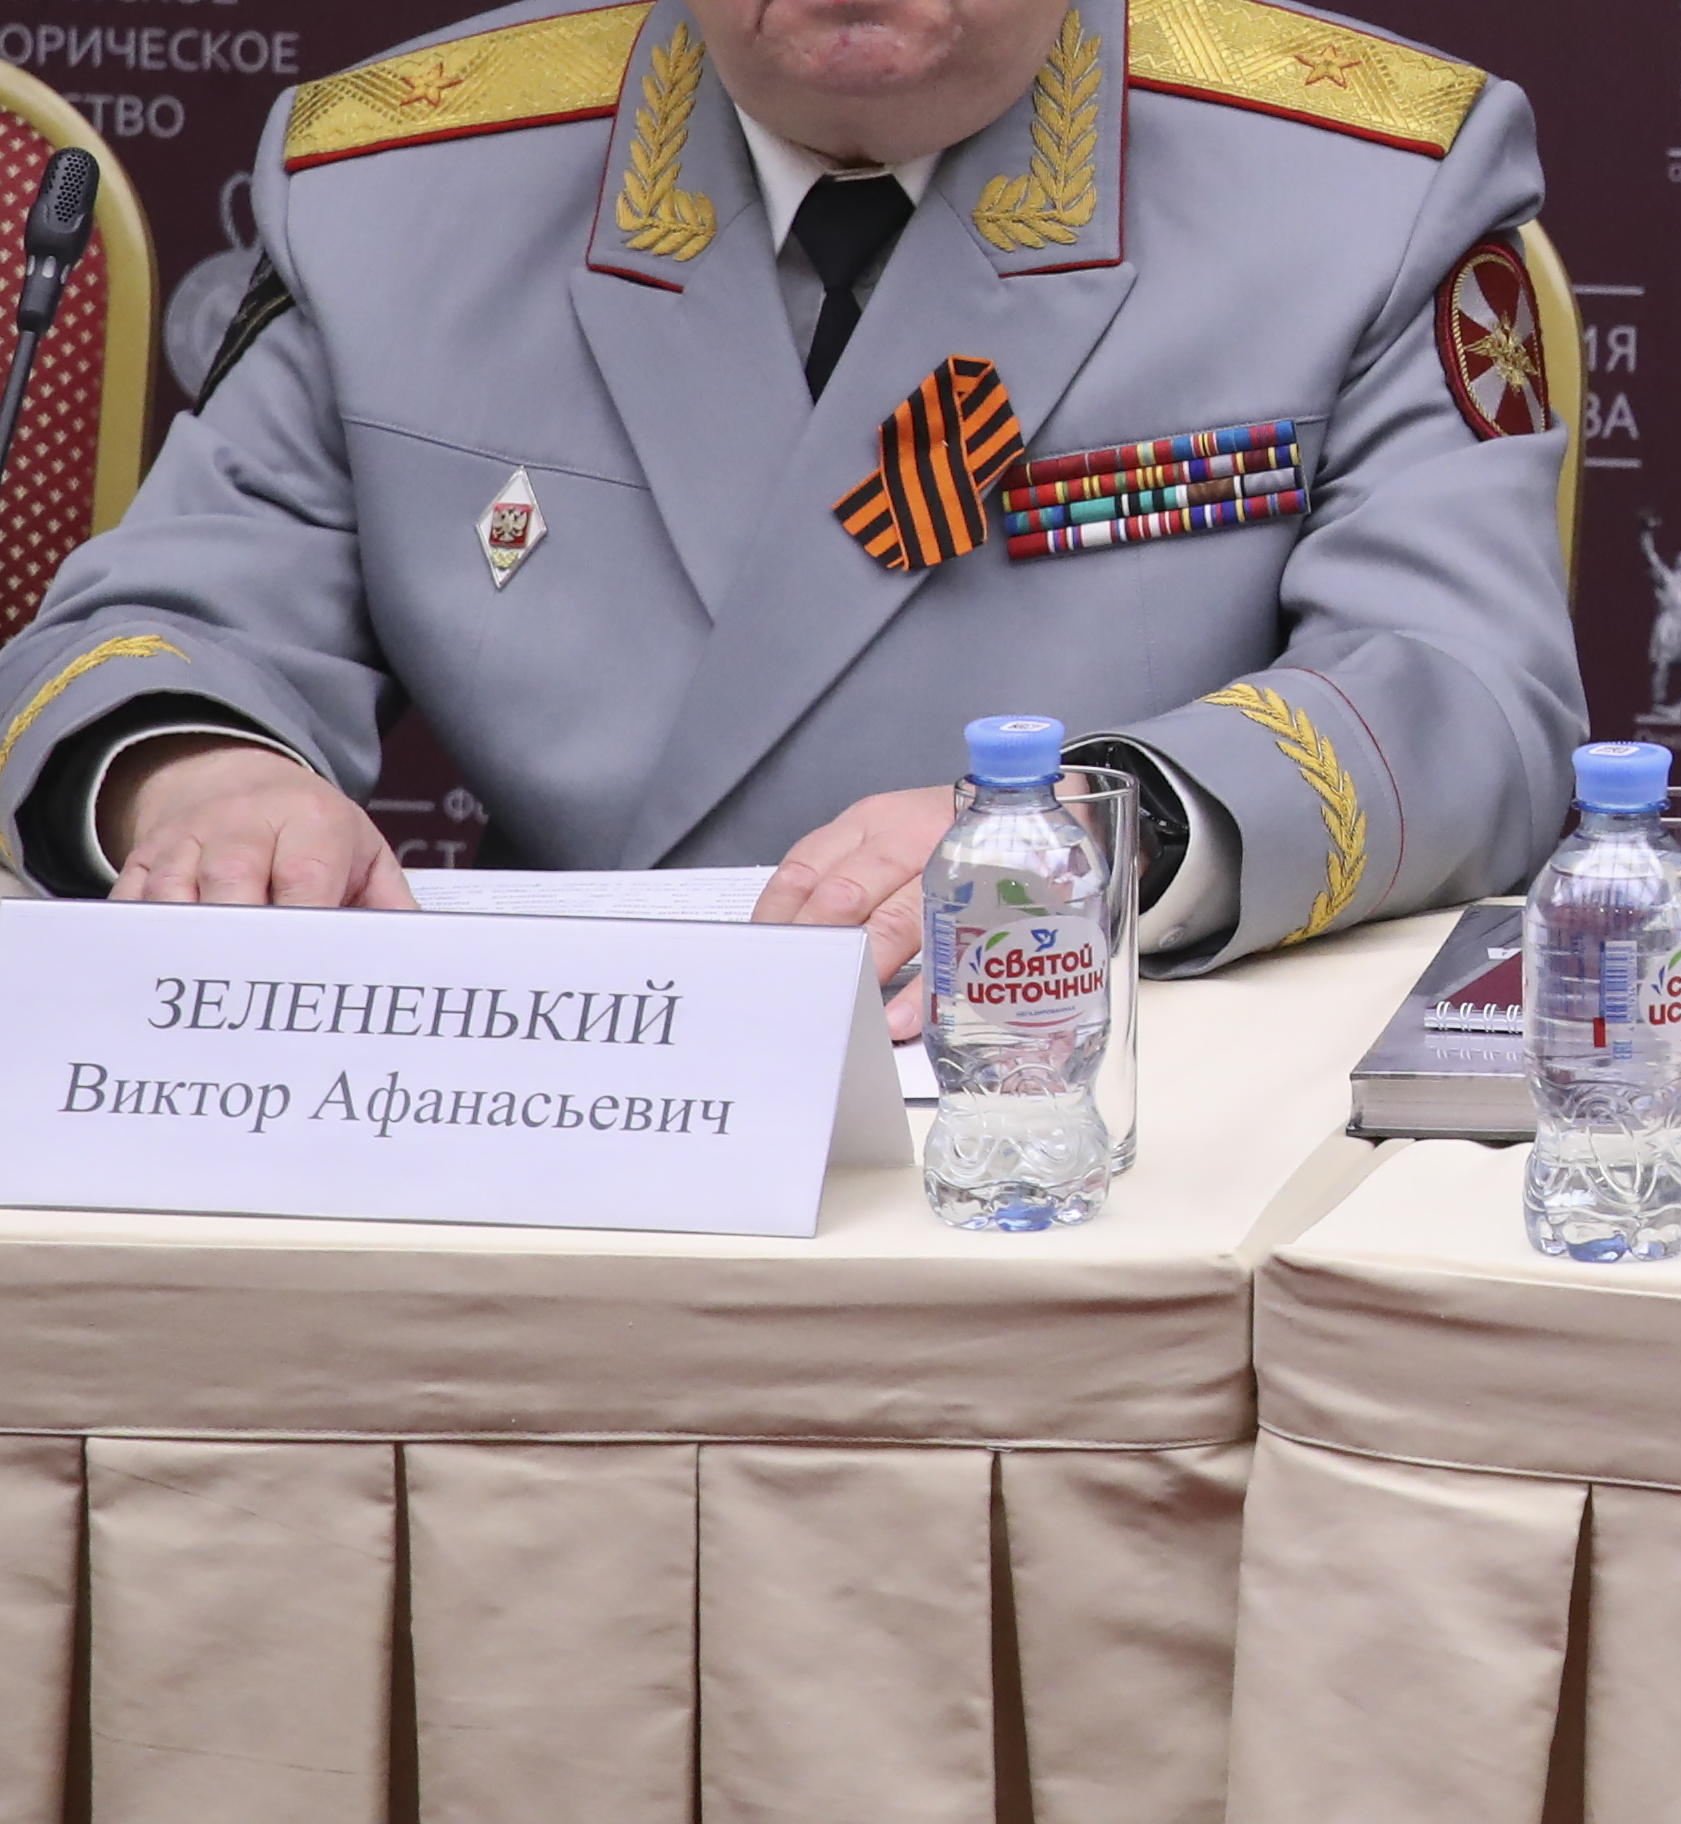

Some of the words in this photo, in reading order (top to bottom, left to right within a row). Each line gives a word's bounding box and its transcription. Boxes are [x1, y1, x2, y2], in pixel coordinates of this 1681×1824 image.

[0, 22, 300, 74] ОРИЧЕСКОЕ
[148, 978, 682, 1045] ЗЕЛЕНЕНЬКИЙ
[58, 1063, 291, 1133] Виктор
[309, 1069, 734, 1138] Афанасьевич
